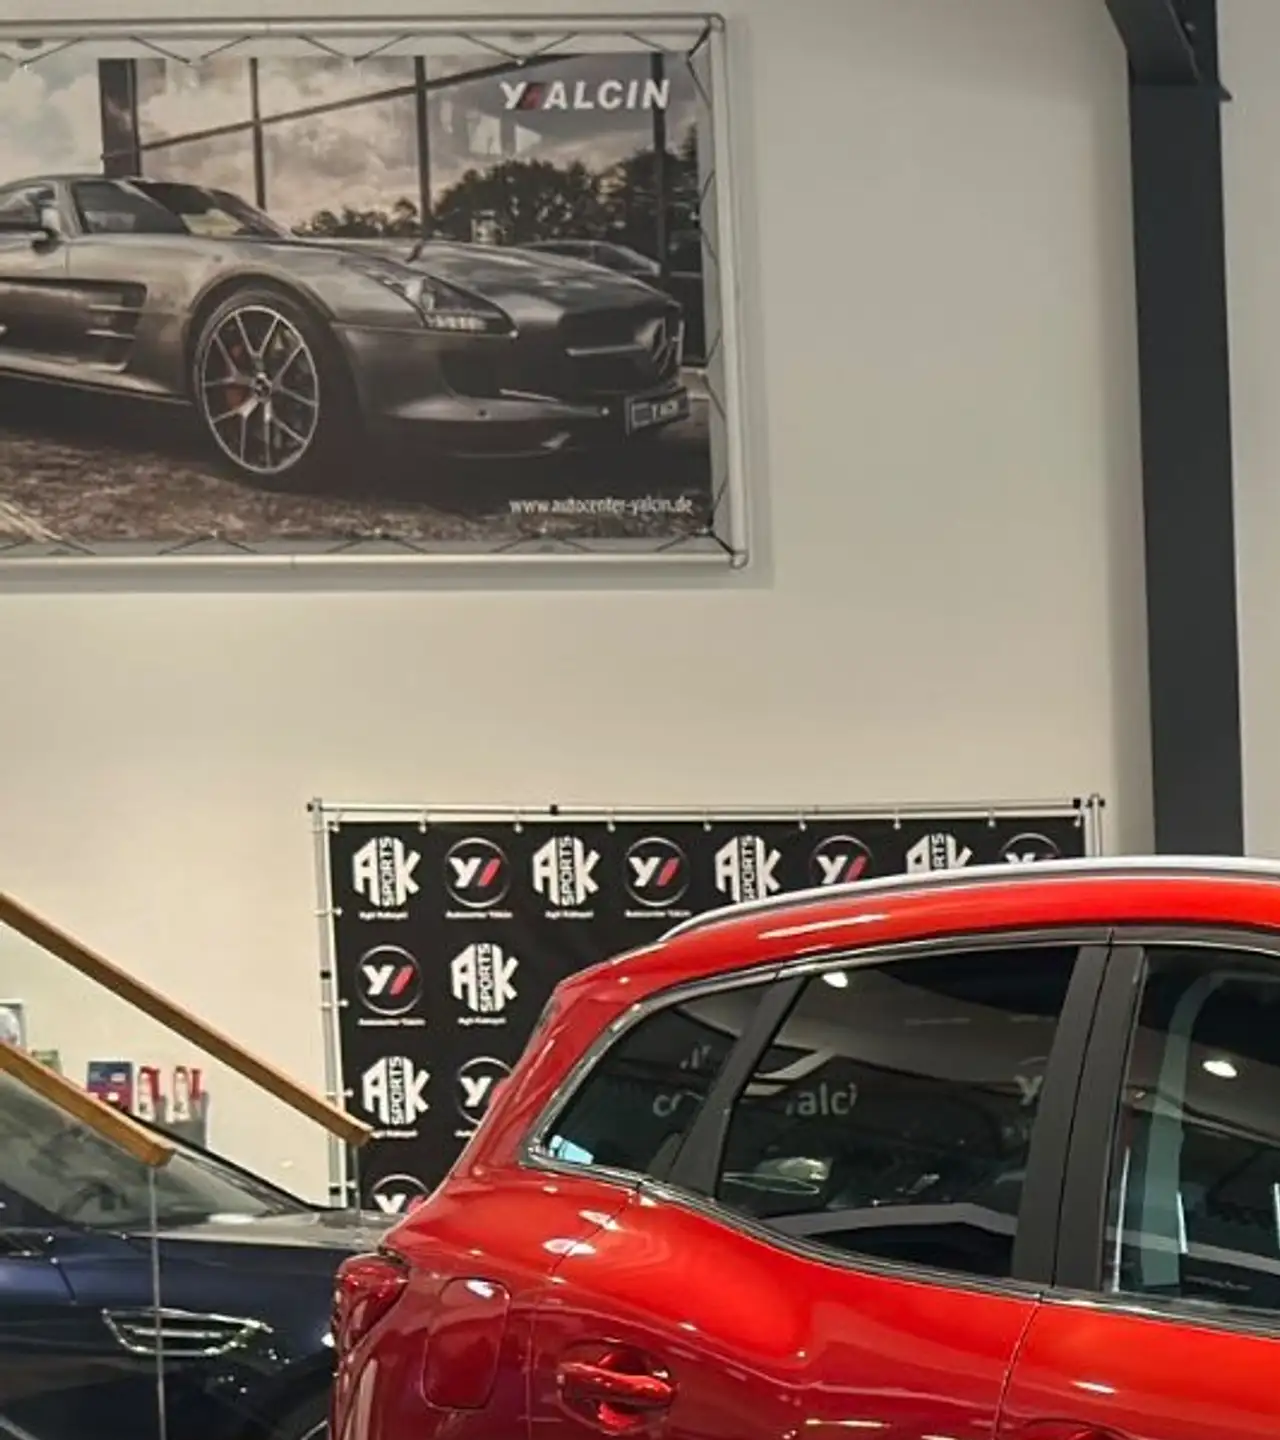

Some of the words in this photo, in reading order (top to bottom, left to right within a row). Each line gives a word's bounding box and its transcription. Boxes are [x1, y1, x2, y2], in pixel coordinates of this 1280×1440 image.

[352, 836, 421, 906] AK
[379, 836, 396, 907] SPORTS
[532, 836, 601, 906] AK
[559, 836, 576, 906] SPORTS
[451, 943, 519, 1012] AK
[477, 943, 494, 1012] SPORTS
[363, 1057, 430, 1125] AK
[389, 1057, 405, 1125] SPORTS
